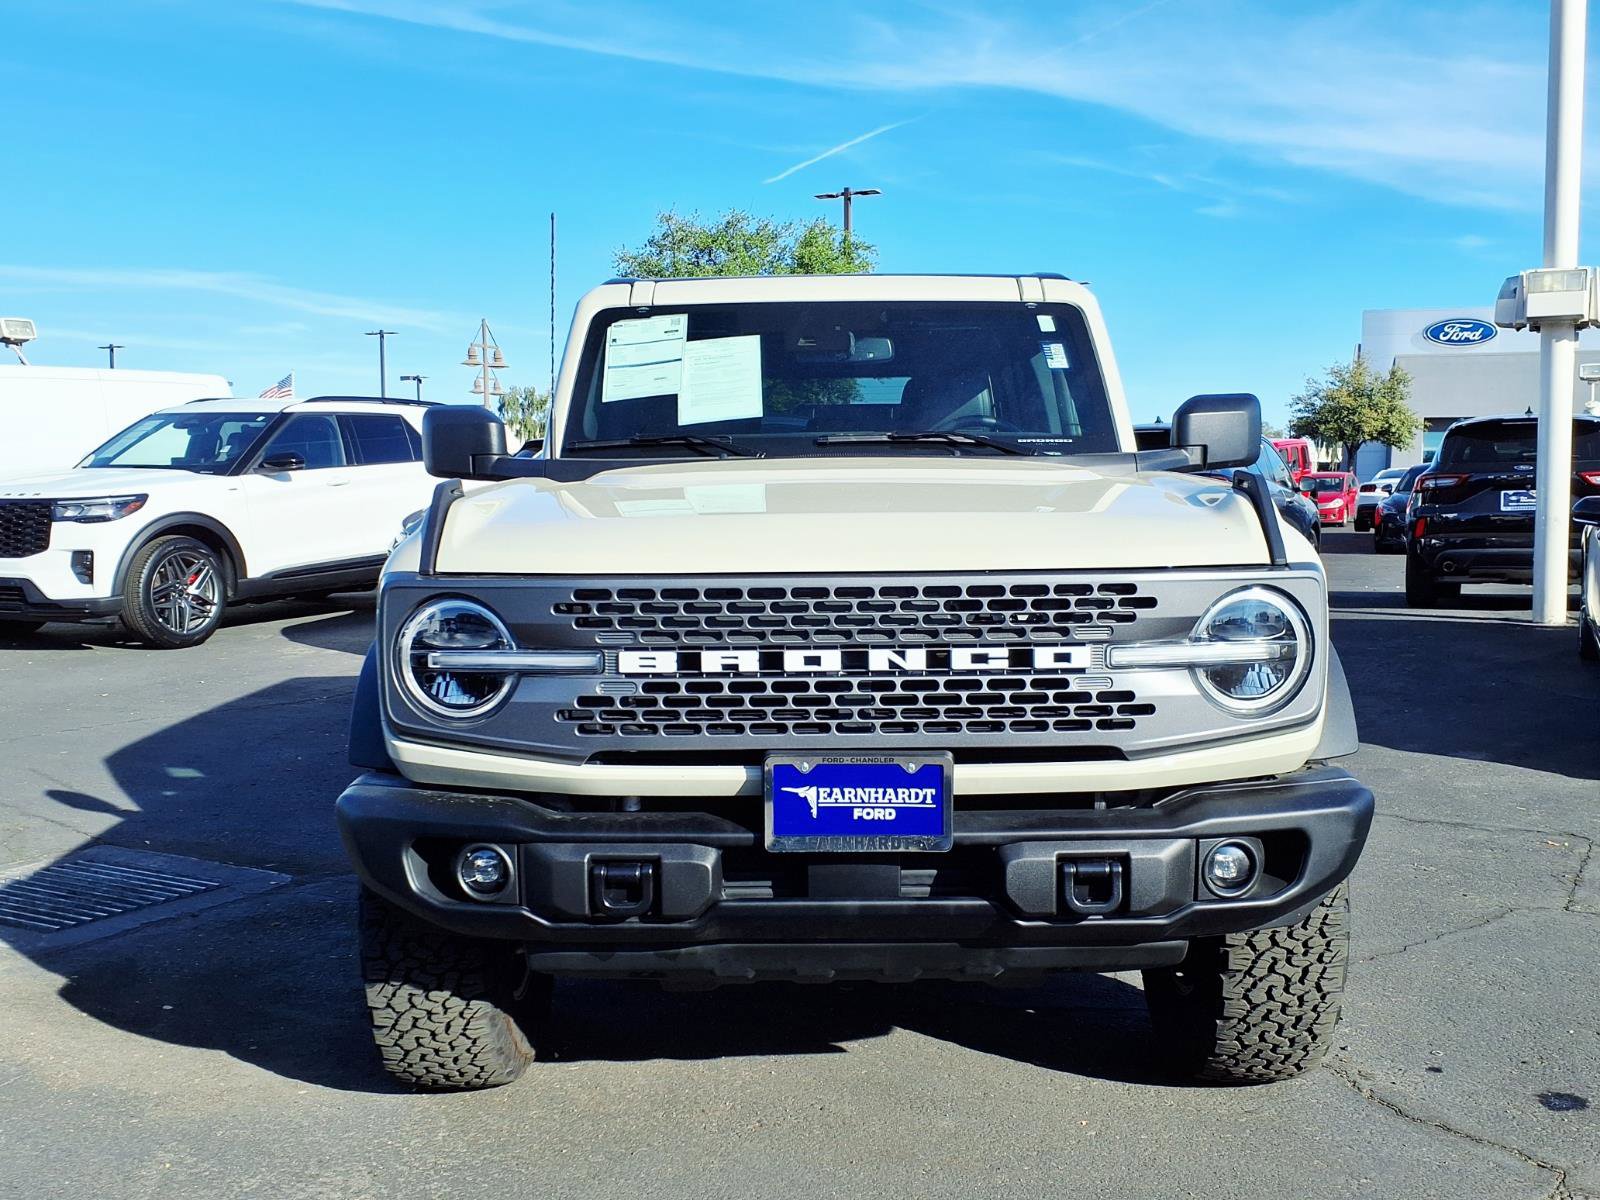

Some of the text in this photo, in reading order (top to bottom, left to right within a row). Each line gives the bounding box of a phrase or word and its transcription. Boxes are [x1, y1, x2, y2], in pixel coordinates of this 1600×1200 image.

[1439, 323, 1485, 341] Ford
[618, 645, 1091, 674] BRONCO
[818, 787, 936, 803] EARNHARDT
[853, 808, 896, 820] FORD
